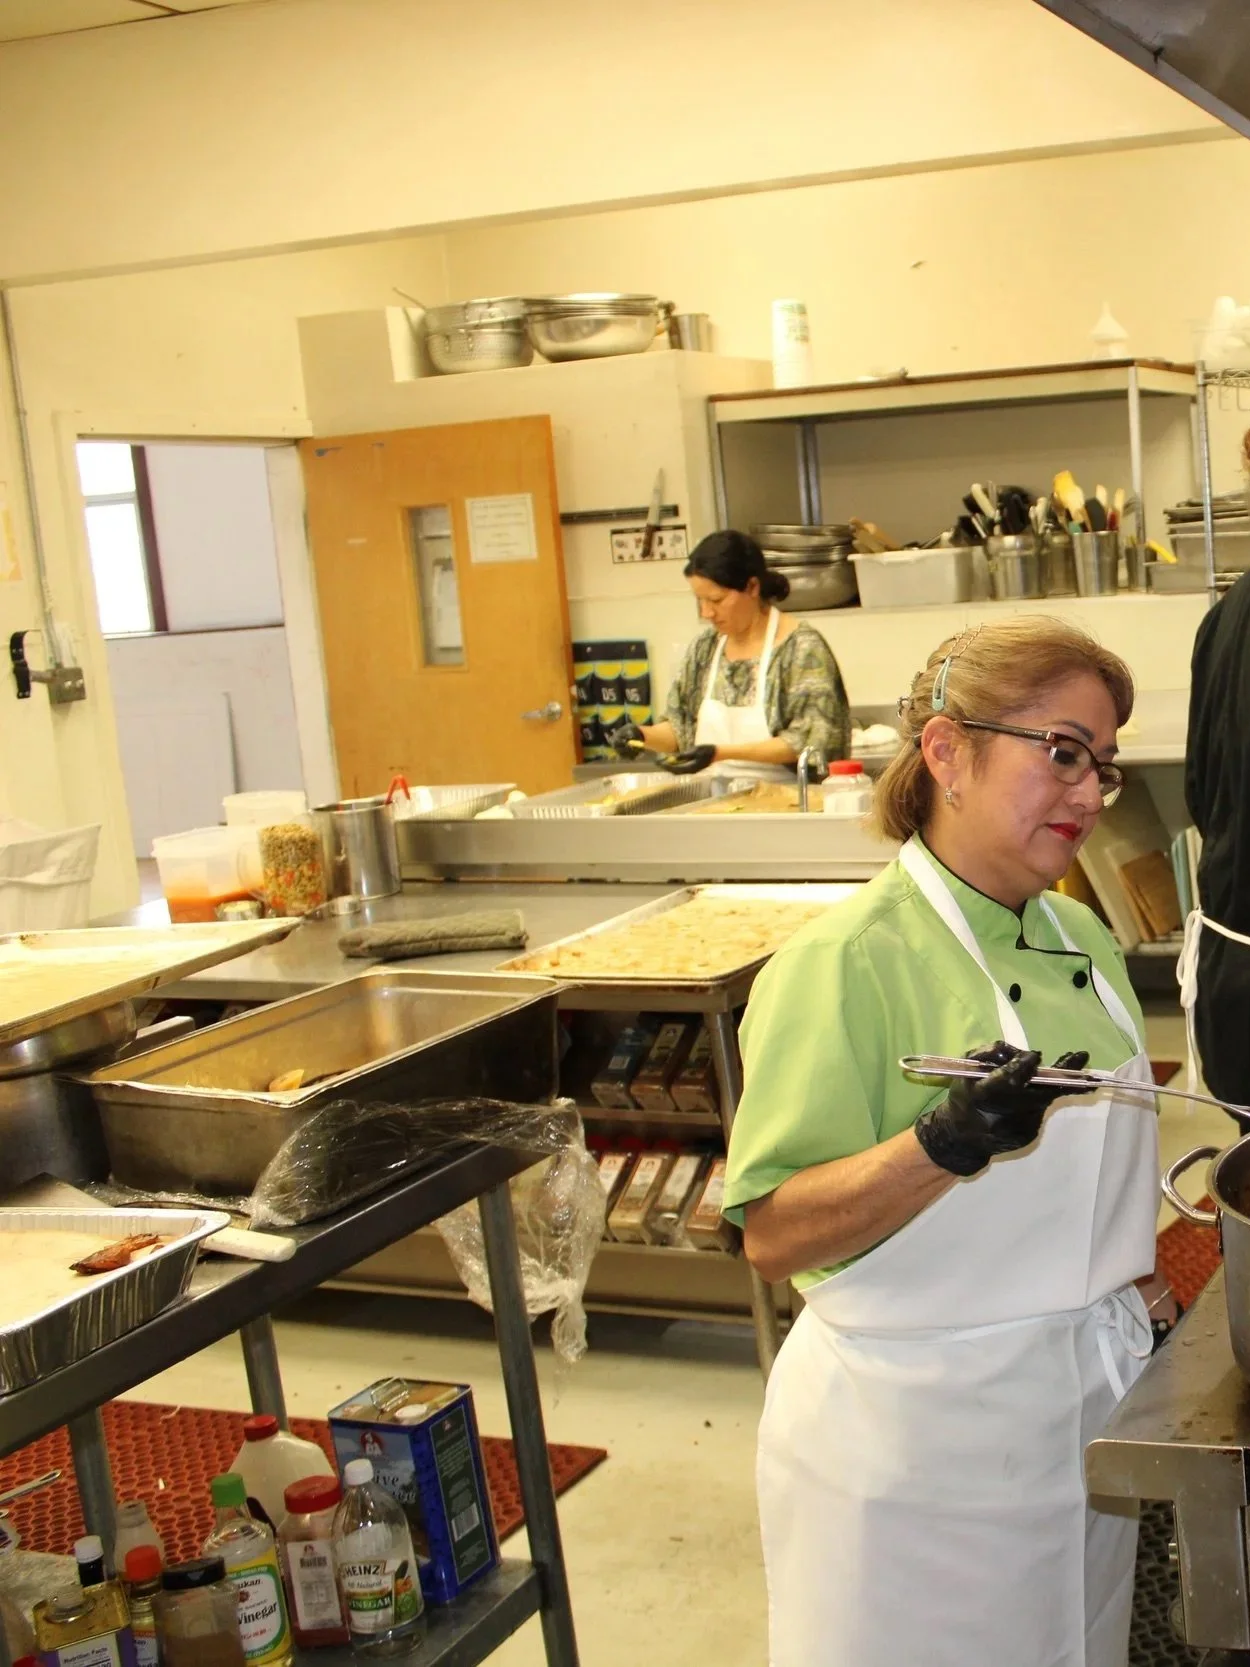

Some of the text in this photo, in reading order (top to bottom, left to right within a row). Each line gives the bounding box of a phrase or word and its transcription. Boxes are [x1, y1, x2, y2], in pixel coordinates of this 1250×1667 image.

[345, 1564, 380, 1576] HEINZ
[238, 1578, 261, 1589] ukan
[238, 1602, 277, 1625] Vinegar
